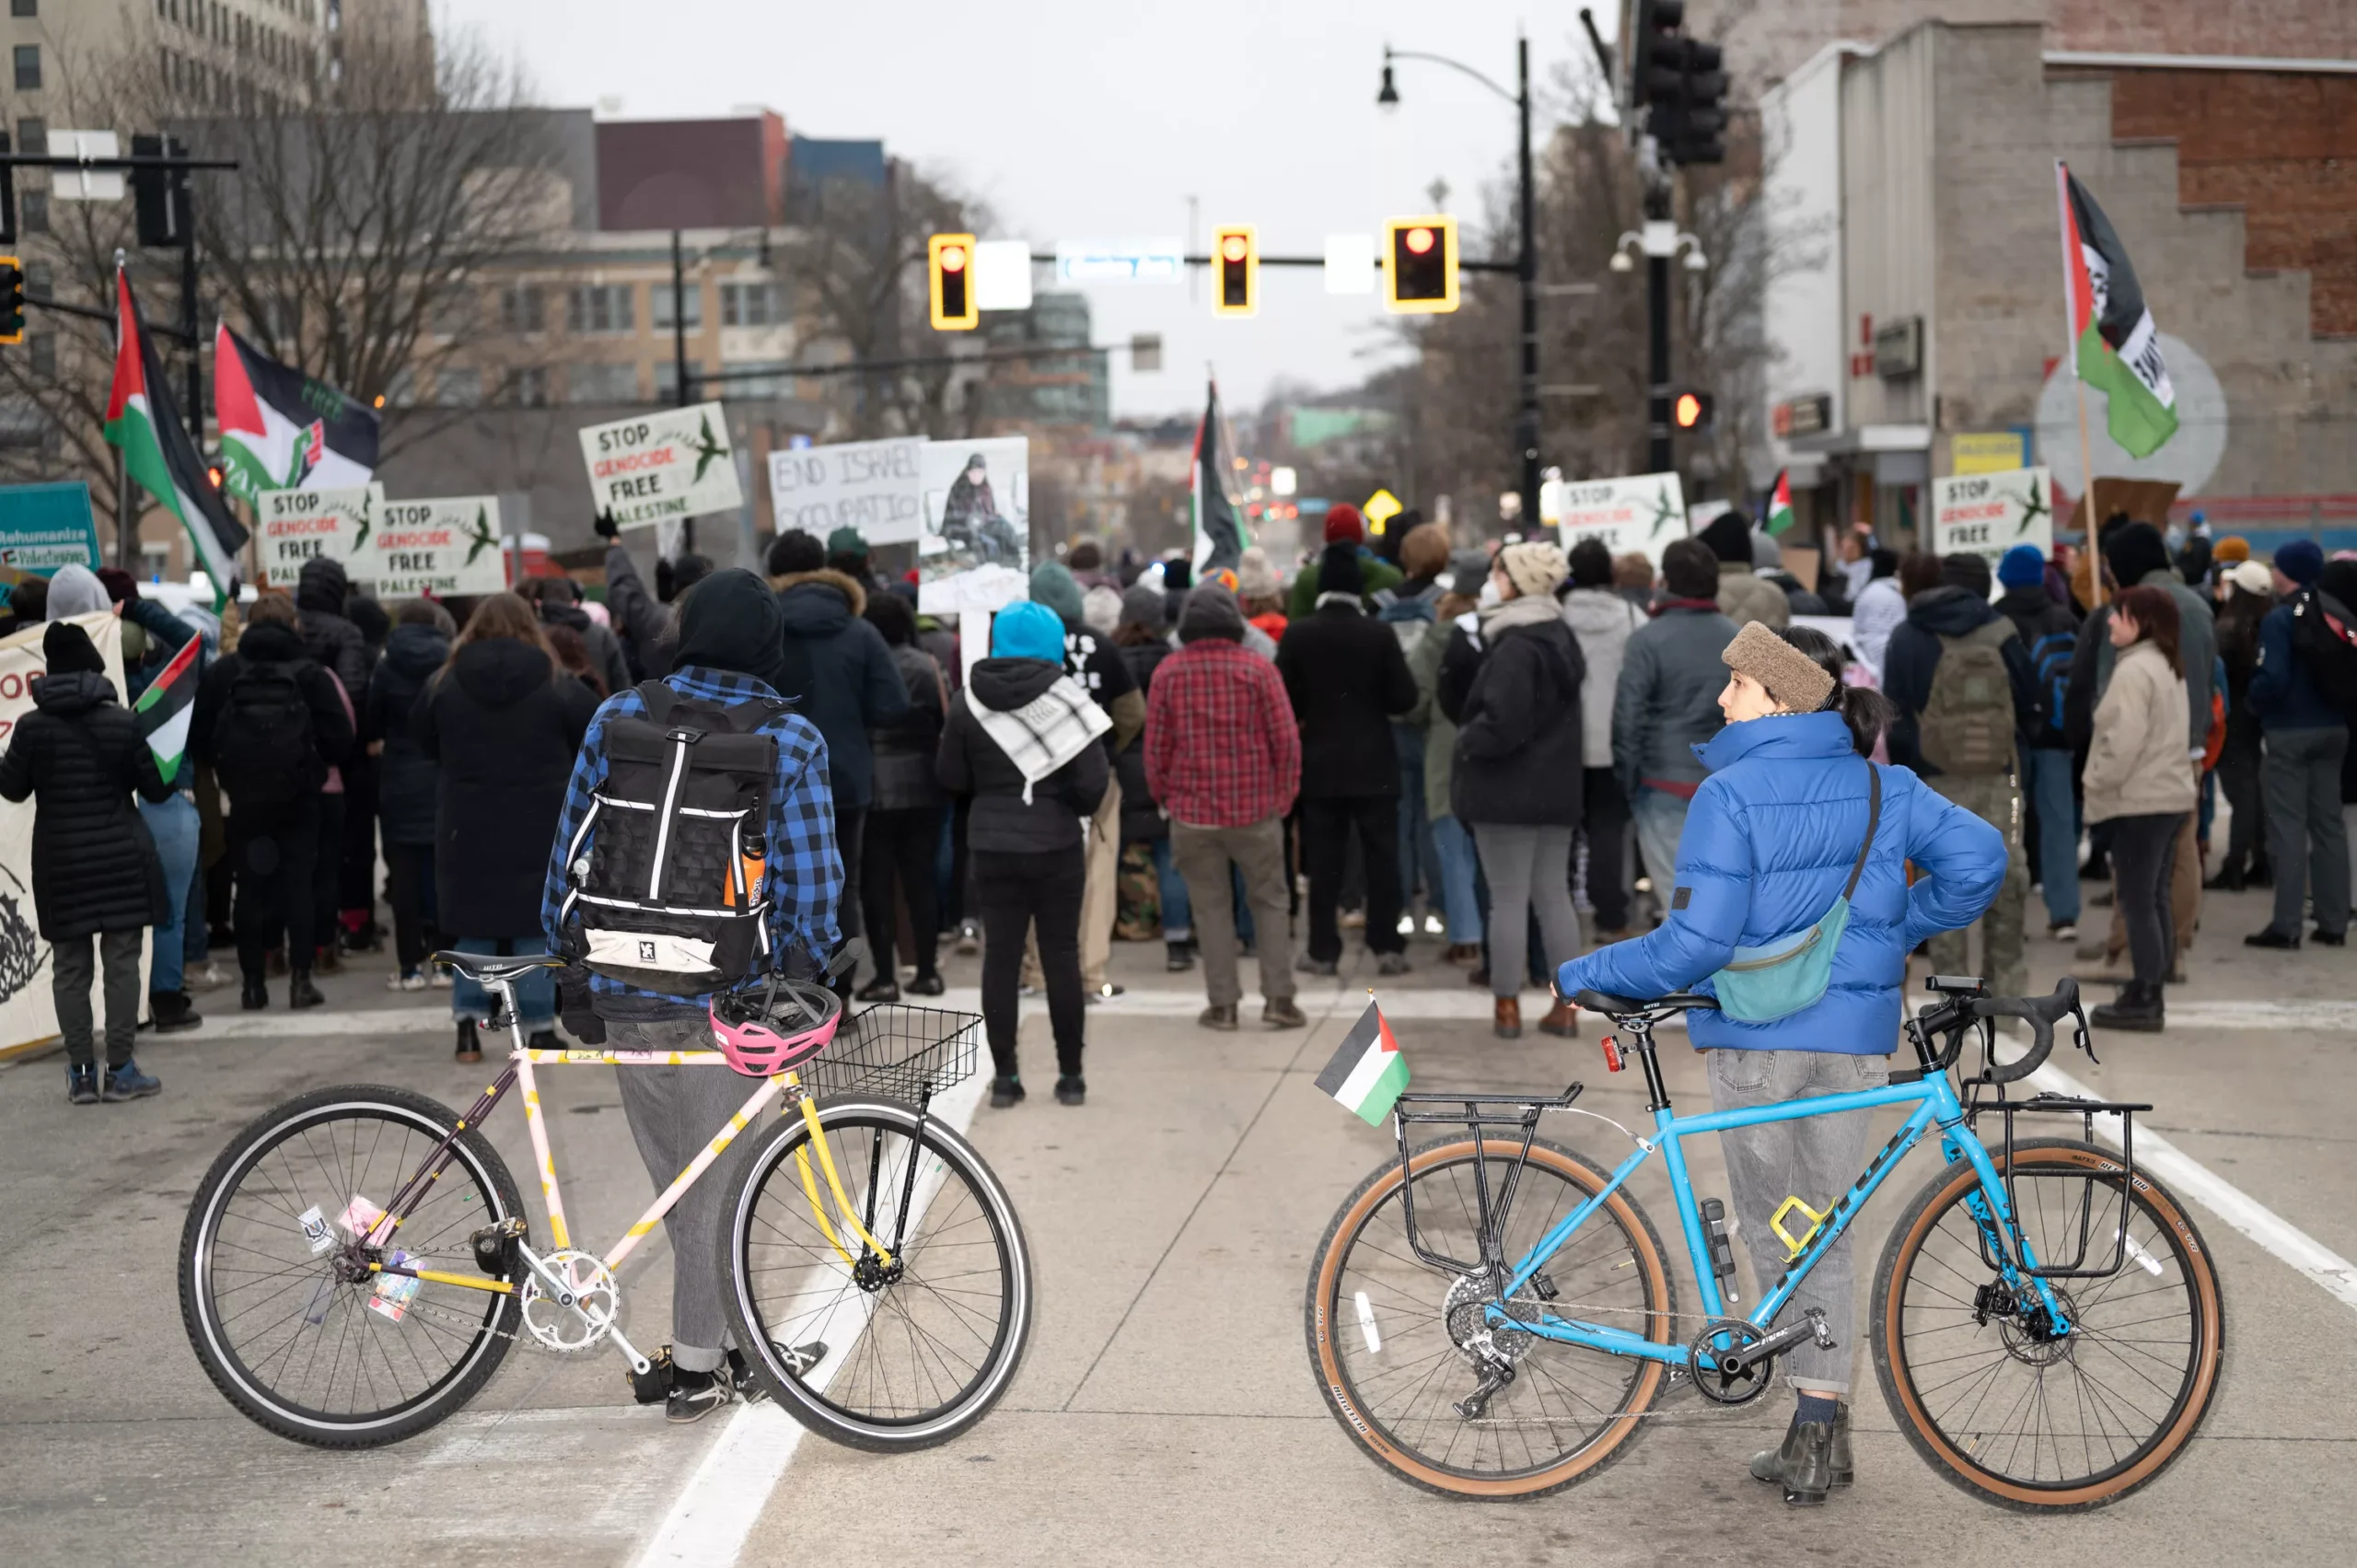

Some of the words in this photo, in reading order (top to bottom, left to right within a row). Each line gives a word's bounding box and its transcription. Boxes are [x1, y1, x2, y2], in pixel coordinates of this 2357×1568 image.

[598, 424, 650, 452] STOP
[594, 447, 677, 478] GENOCIDE
[776, 457, 826, 493] END
[610, 474, 663, 503] FREE
[1570, 485, 1614, 505] STOP
[1947, 480, 1990, 503] STOP
[273, 493, 319, 514] STOP
[616, 496, 689, 525] ALESTINE
[778, 494, 919, 531] OCCUPATIO
[267, 517, 338, 537] GENOCIDE
[384, 505, 431, 528] STOP
[377, 530, 450, 550] GENOCIDE
[1948, 524, 1991, 547] FREE
[279, 539, 324, 560] FREE
[389, 552, 435, 573] FREE
